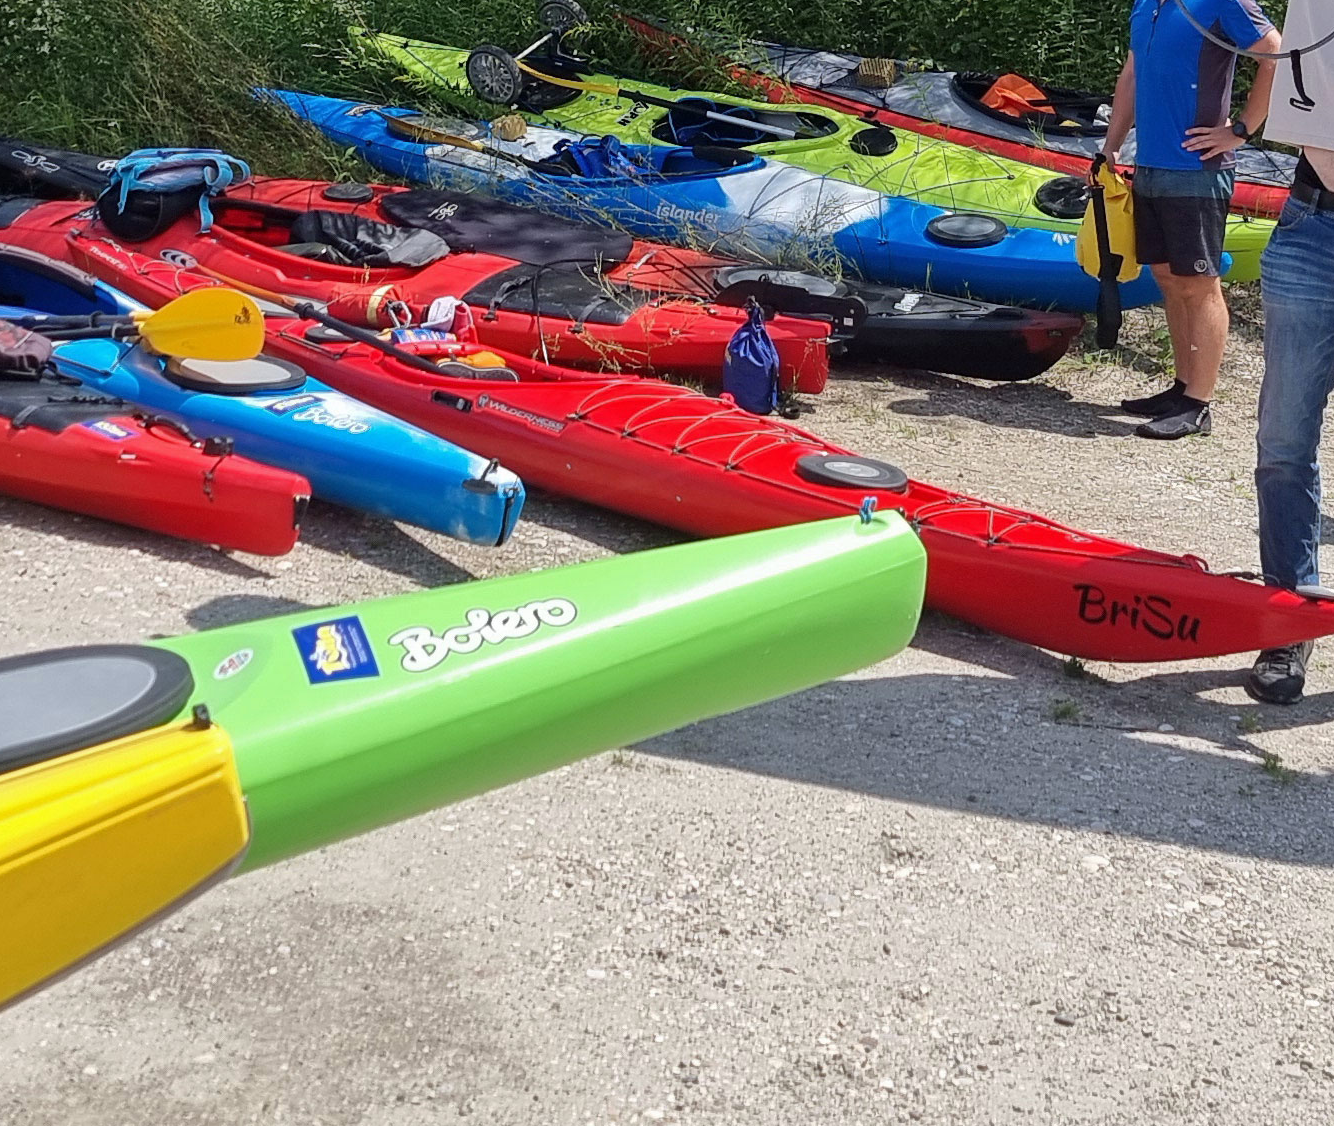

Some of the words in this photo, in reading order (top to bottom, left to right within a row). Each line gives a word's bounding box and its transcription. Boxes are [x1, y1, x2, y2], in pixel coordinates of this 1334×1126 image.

[656, 202, 722, 224] islander
[489, 400, 565, 431] WILDERNESS
[387, 597, 578, 673] Bolero
[1073, 583, 1201, 644] BriSu
